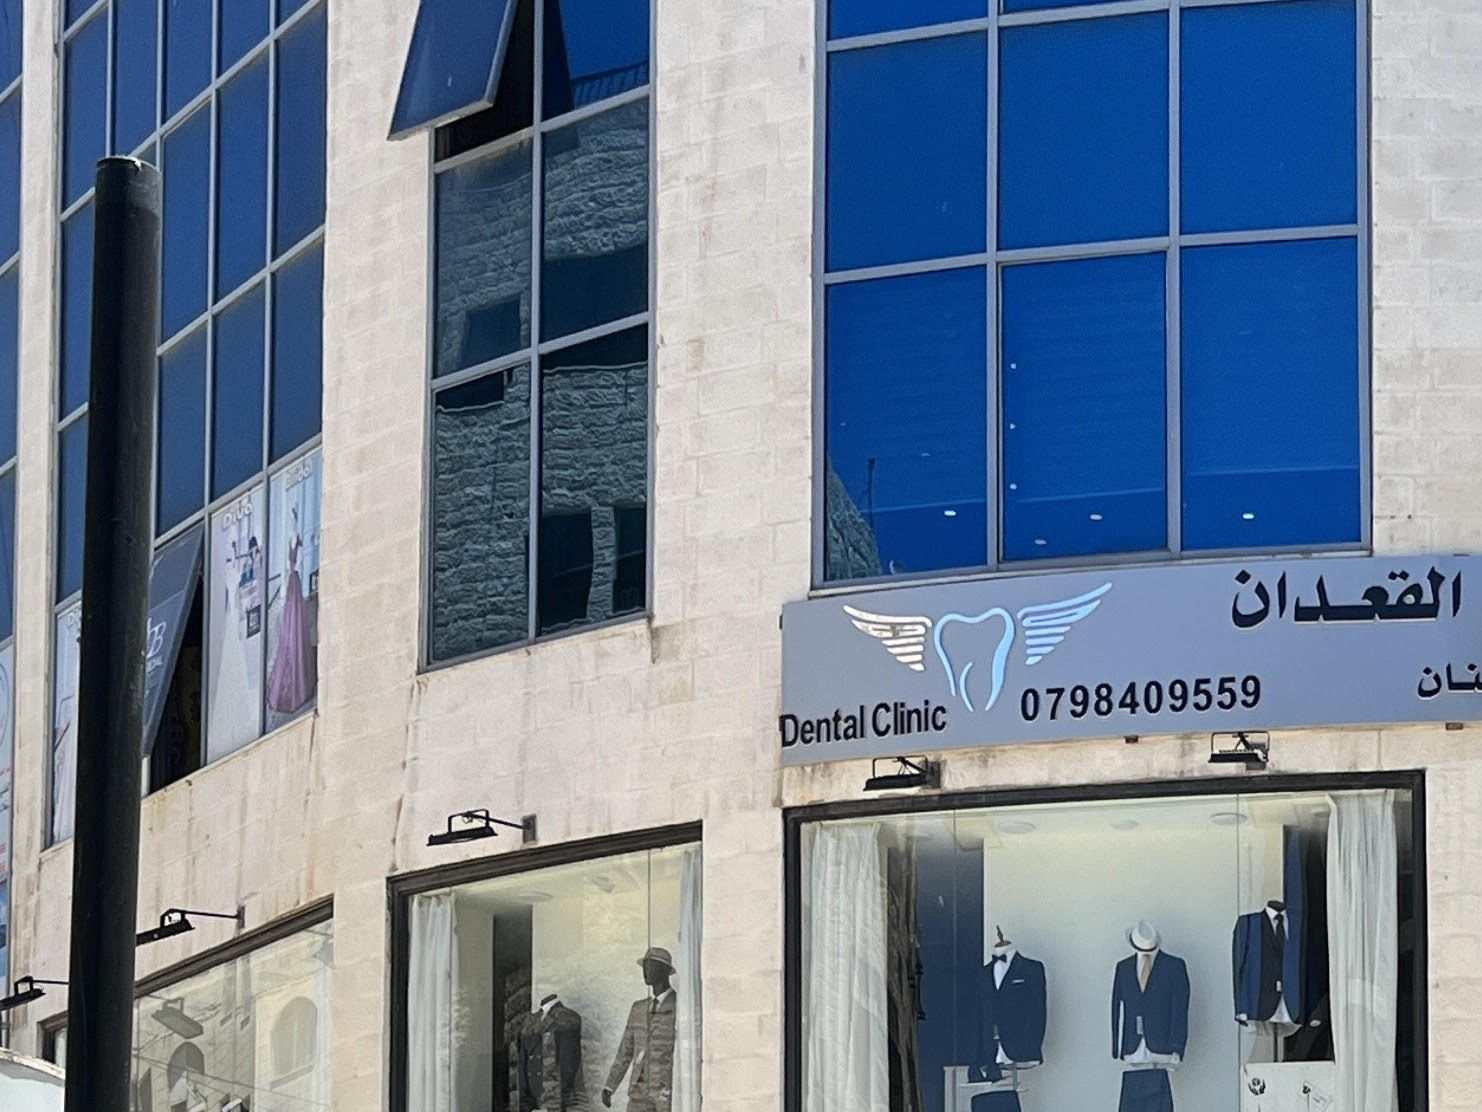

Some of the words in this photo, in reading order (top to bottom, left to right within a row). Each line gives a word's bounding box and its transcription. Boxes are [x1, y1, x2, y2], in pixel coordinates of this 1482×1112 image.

[1231, 565, 1462, 628] القعدان
[780, 706, 867, 747] Dental
[871, 699, 947, 737] Clinic
[1021, 675, 1262, 723] 0798409559
